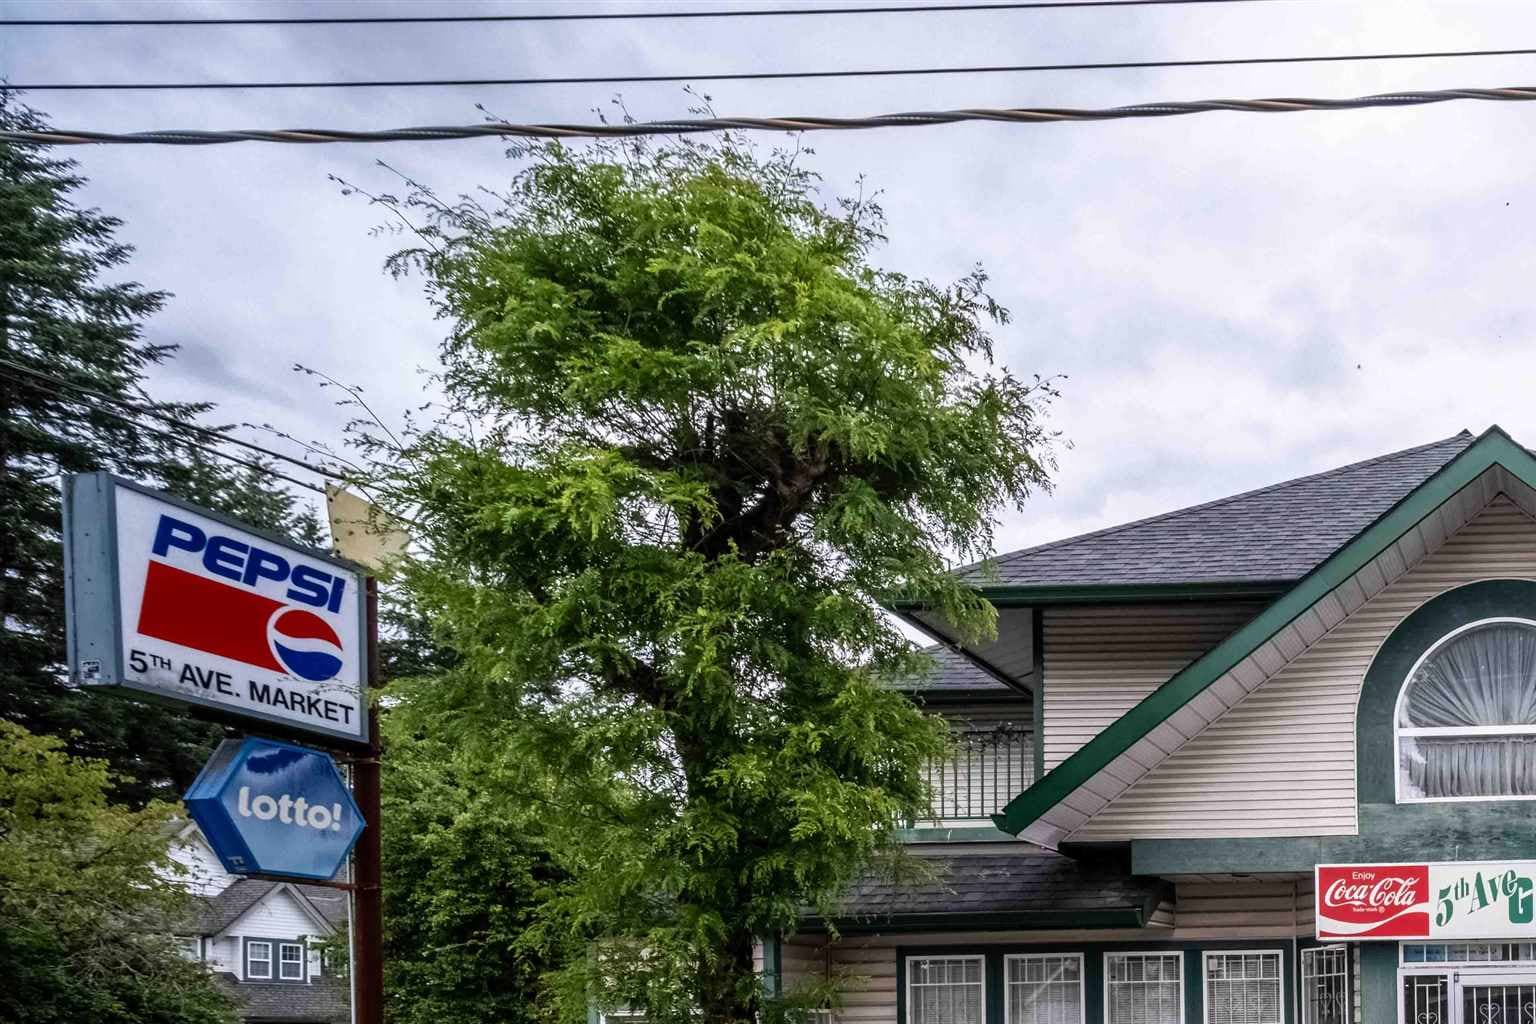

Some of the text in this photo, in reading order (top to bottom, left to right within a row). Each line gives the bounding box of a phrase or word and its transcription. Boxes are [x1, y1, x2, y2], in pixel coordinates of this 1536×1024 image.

[152, 513, 346, 614] PEPSI
[129, 649, 172, 675] 5TH
[179, 663, 241, 698] AVE.
[249, 680, 354, 725] MARKET
[238, 785, 343, 831] lotto!
[1324, 878, 1420, 907] Coca-Cola
[1352, 871, 1375, 880] Enjoy
[1435, 877, 1470, 928] 5th
[1467, 869, 1518, 916] Ave
